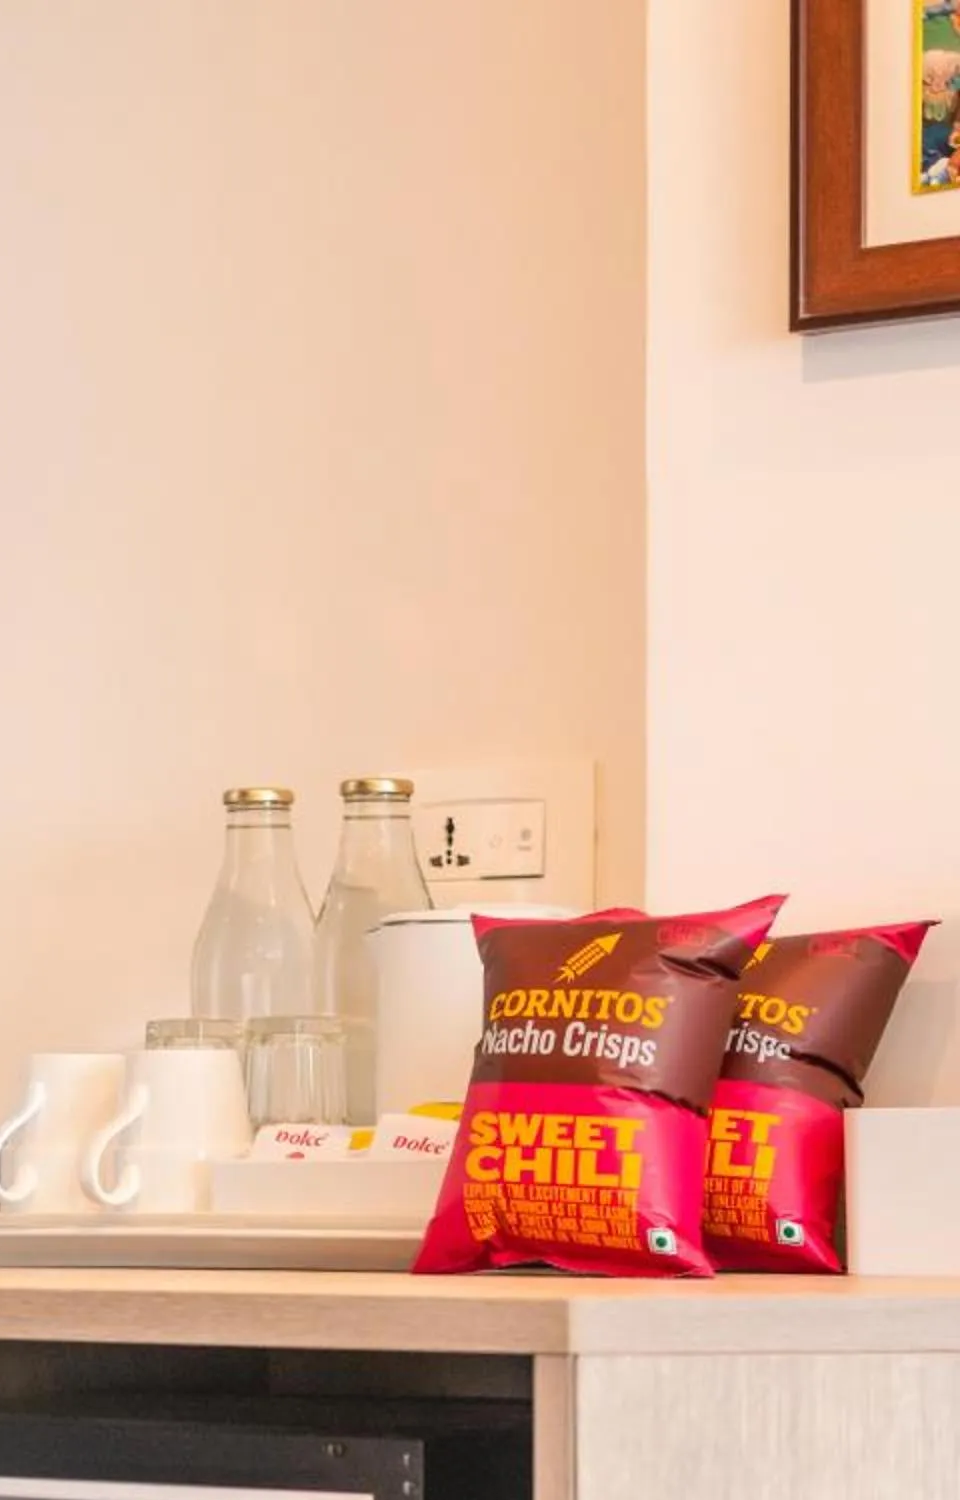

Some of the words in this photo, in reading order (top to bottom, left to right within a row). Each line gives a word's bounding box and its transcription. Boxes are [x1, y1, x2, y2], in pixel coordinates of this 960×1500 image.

[490, 988, 668, 1029] CORNITOS
[738, 993, 810, 1035] TOS
[482, 1020, 557, 1056] Nacho
[562, 1021, 657, 1069] Crisps
[725, 1021, 792, 1064] risps
[469, 1111, 647, 1151] SWEET
[709, 1108, 783, 1145] ET
[465, 1146, 643, 1190] CHILI
[706, 1140, 777, 1180] LI
